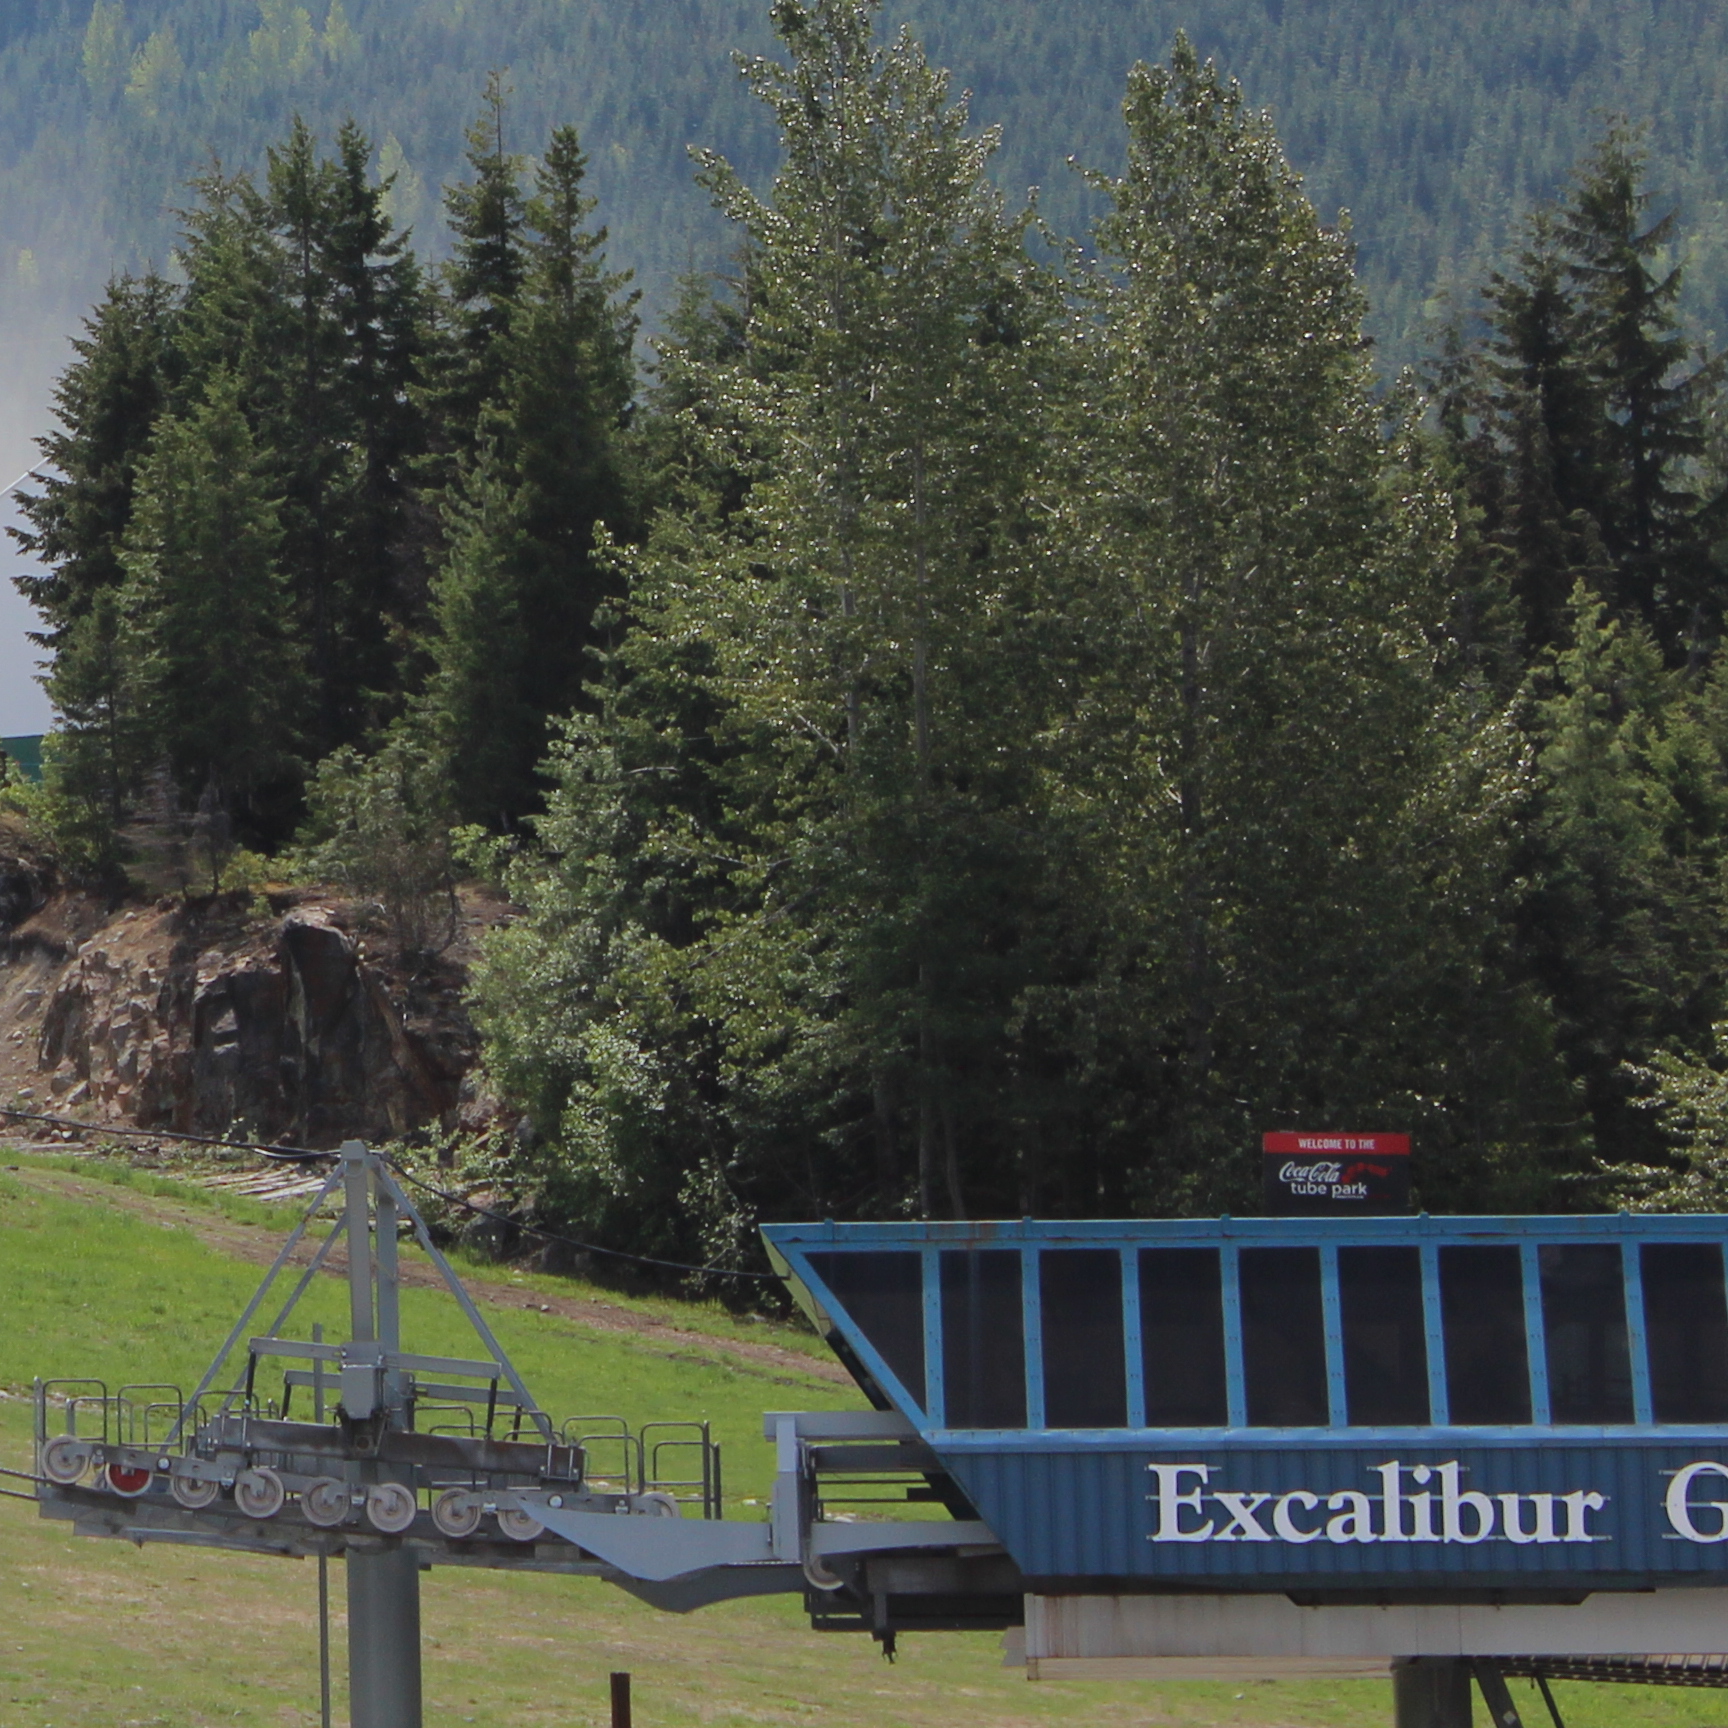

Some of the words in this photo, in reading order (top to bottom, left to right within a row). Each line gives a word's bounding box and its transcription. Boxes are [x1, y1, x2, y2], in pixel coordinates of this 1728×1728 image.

[1298, 1138, 1342, 1149] WELCOME
[1345, 1139, 1356, 1149] TO
[1358, 1139, 1375, 1149] THE
[1279, 1161, 1342, 1183] Coca-Cola
[1291, 1182, 1327, 1195] tube
[1331, 1182, 1367, 1199] park
[1148, 1460, 1604, 1544] Excalibur
